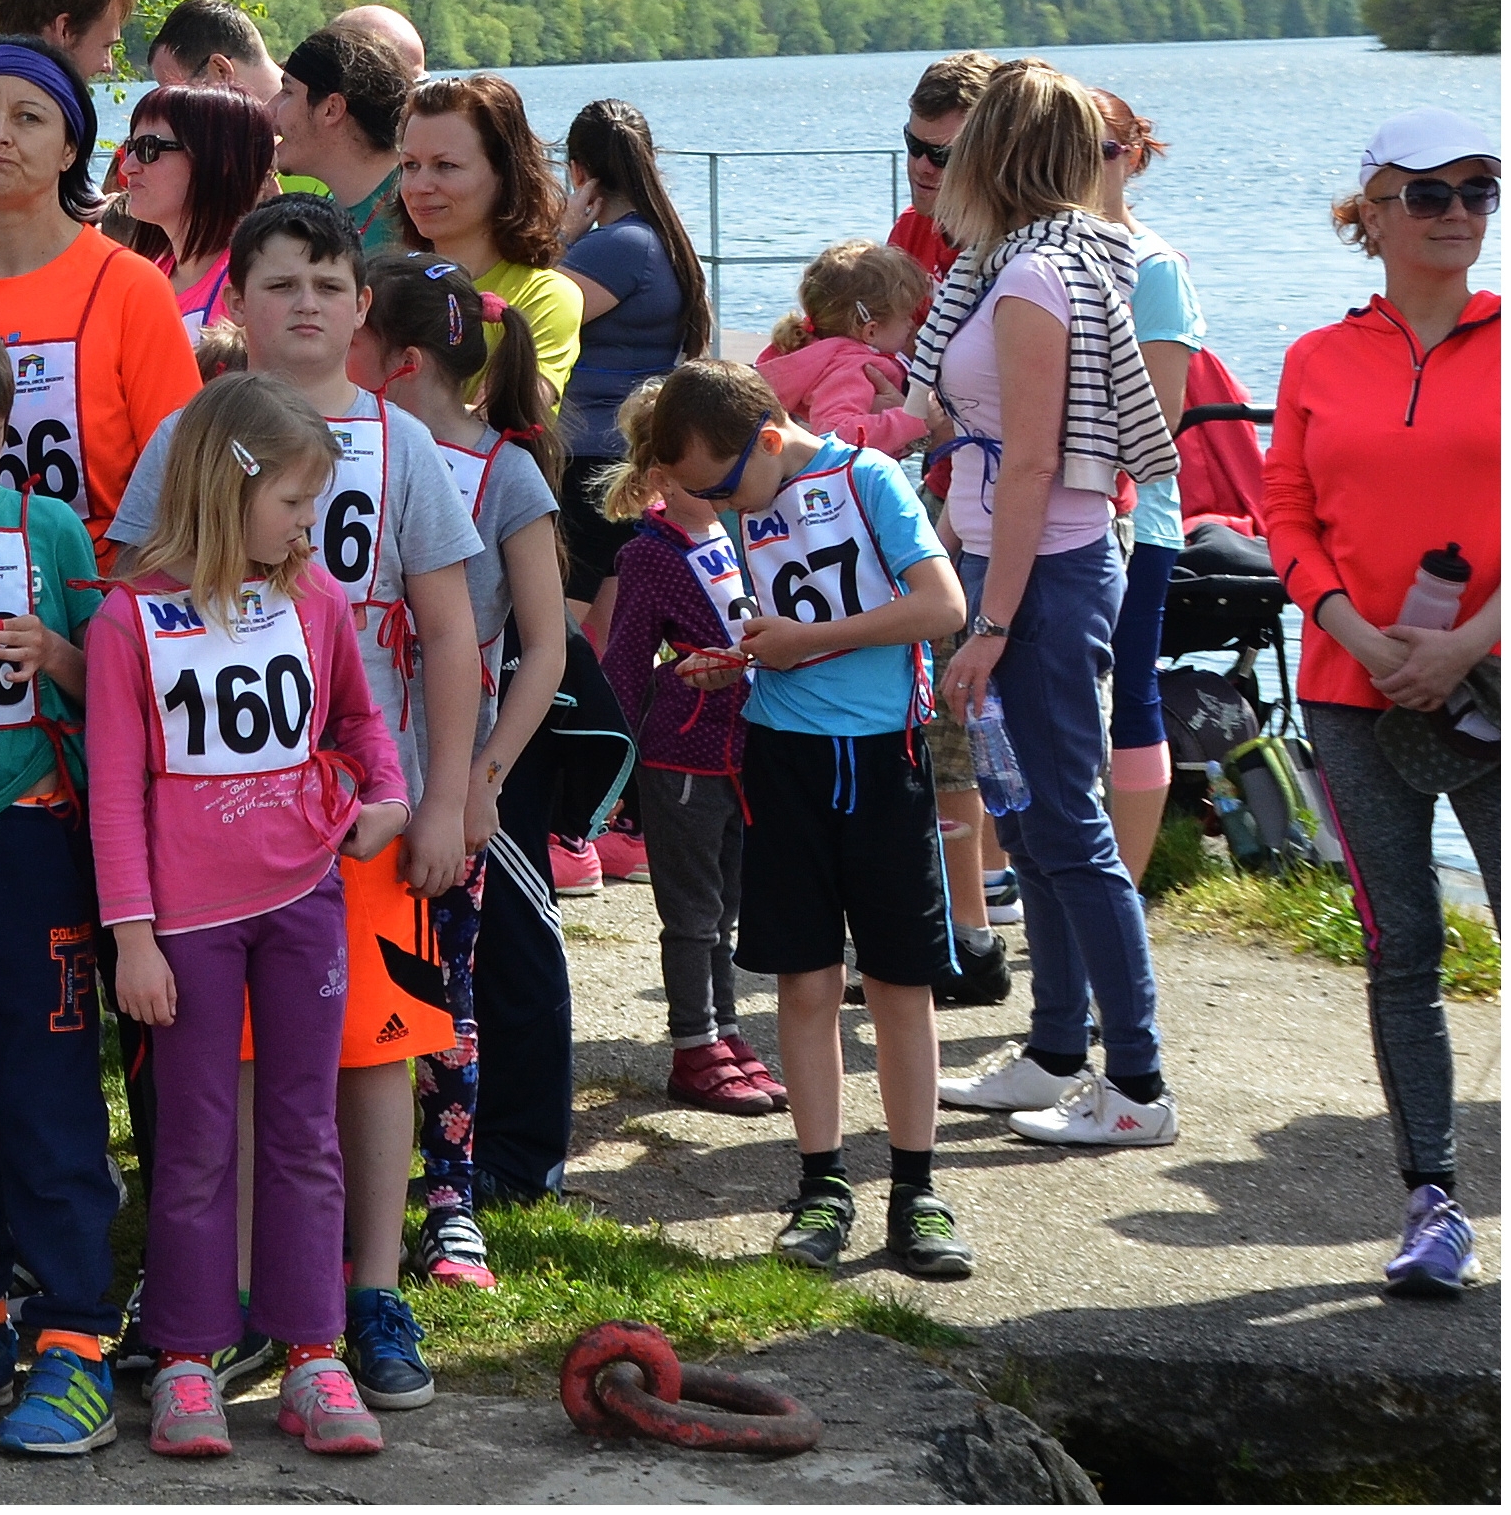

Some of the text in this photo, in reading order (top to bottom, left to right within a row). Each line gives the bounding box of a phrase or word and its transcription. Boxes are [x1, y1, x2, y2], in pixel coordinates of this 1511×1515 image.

[772, 536, 864, 624] 67
[164, 654, 312, 756] 160
[376, 1027, 410, 1044] adidas
